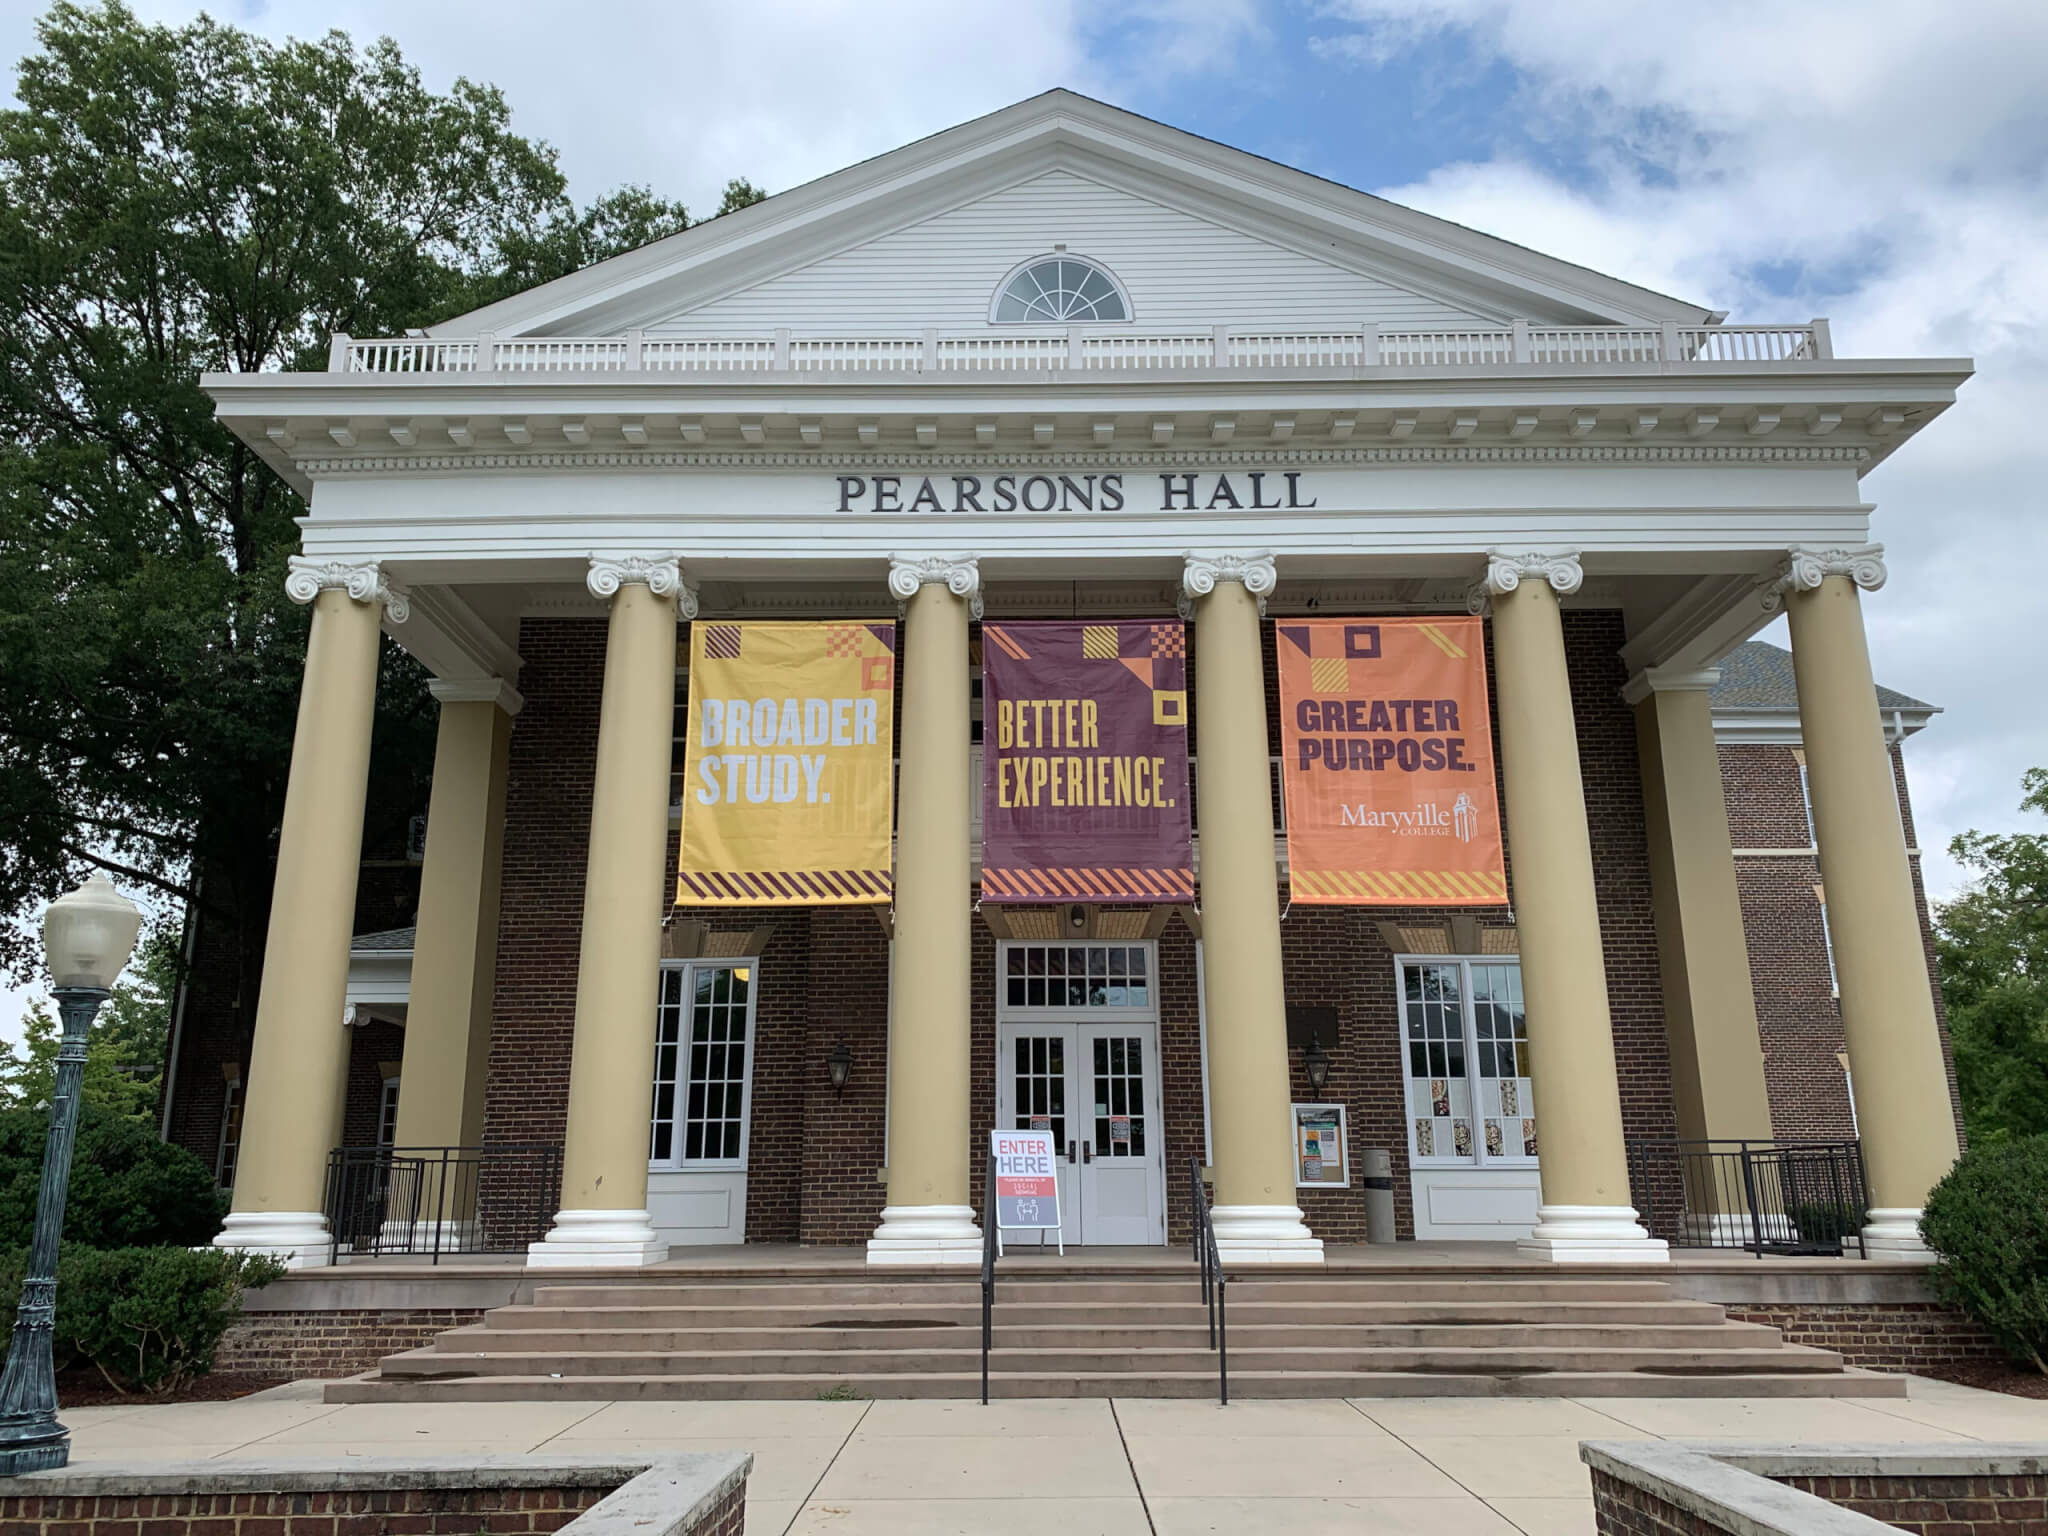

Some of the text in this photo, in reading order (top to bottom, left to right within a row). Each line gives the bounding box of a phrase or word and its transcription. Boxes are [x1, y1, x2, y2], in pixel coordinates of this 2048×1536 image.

[836, 472, 1318, 512] PEARSONS HALL
[701, 697, 878, 747] BROADER
[998, 699, 1099, 749] BETTER
[1296, 699, 1460, 732] GREATER
[1298, 738, 1476, 772] PURPOSE.
[696, 754, 831, 805] STUDY.
[998, 756, 1176, 808] EXPERIENCE.
[1339, 803, 1451, 833] Maryville
[1399, 827, 1451, 837] COLLEGE
[999, 1140, 1047, 1155] ENTER
[1000, 1157, 1049, 1174] HERE
